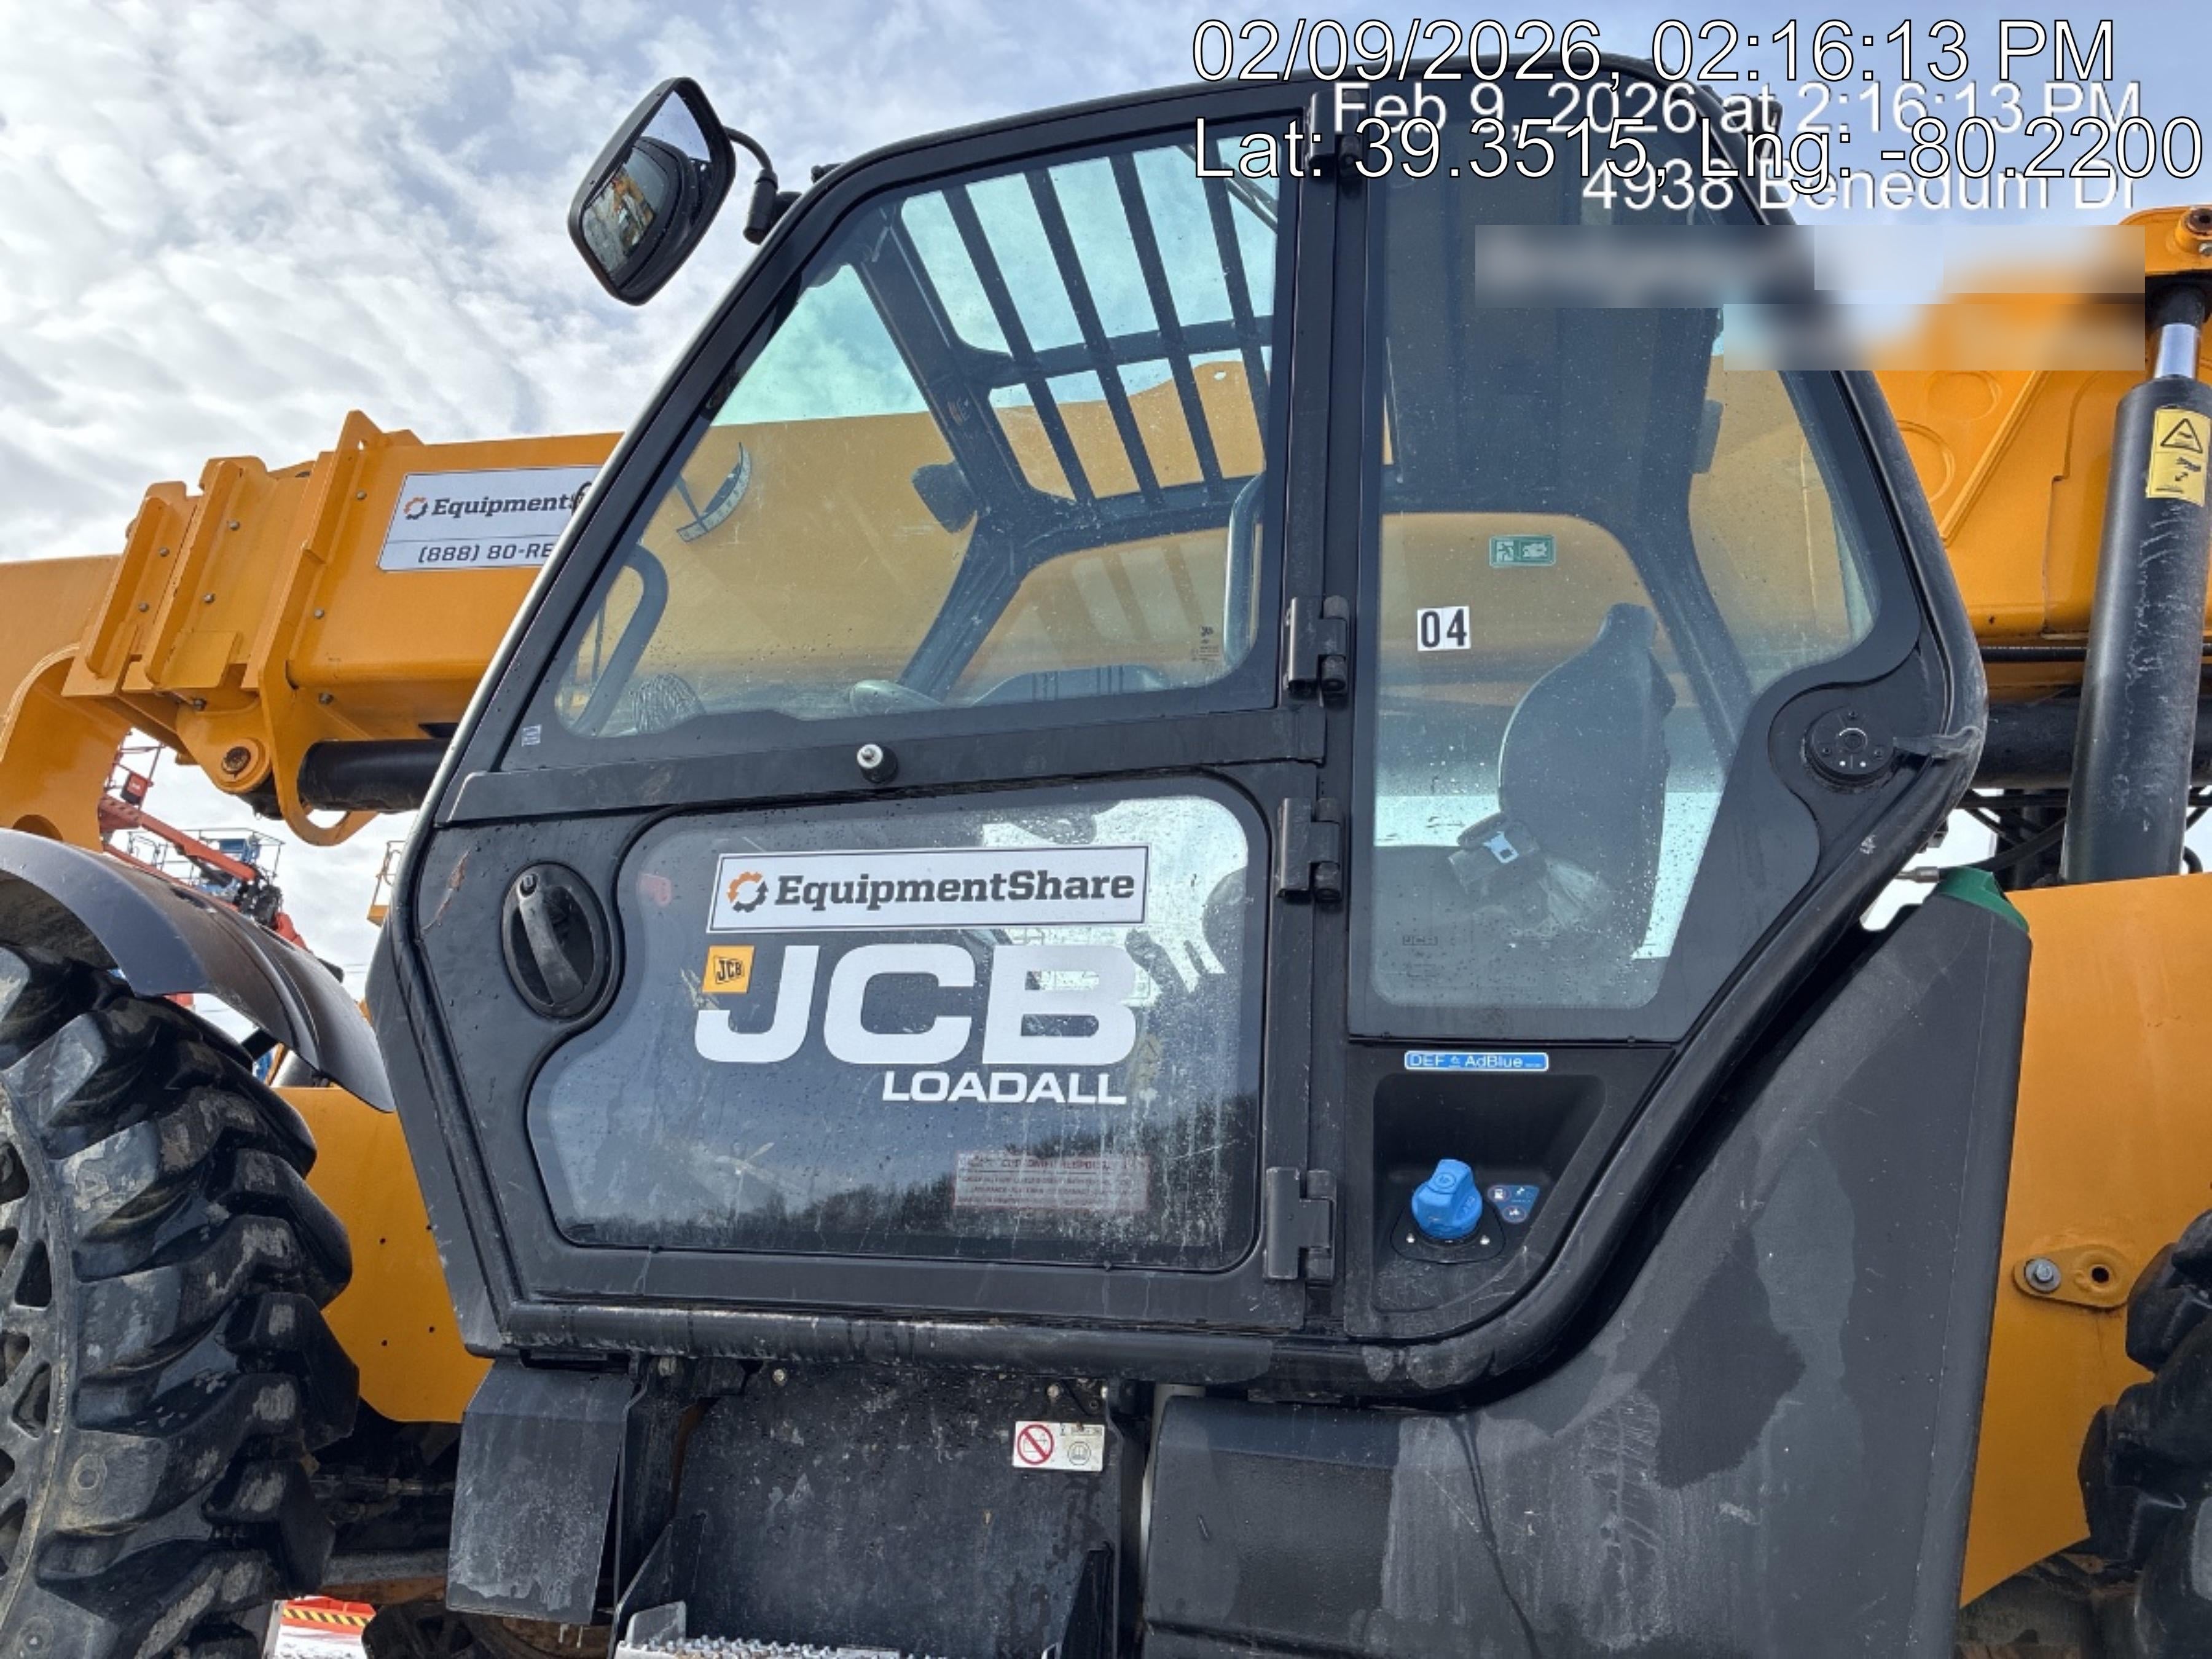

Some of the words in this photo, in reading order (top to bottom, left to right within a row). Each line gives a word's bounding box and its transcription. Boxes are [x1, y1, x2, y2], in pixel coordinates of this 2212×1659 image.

[431, 493, 578, 520] Equipment
[418, 544, 480, 563] (888)
[1421, 608, 1467, 648] 04
[774, 869, 1135, 911] EquipmentShare
[716, 960, 742, 981] JCB
[694, 943, 1137, 1066] JCB
[1409, 1054, 1446, 1067] DEF
[1465, 1054, 1524, 1068] AdBlue
[882, 1071, 1127, 1105] LOADALL
